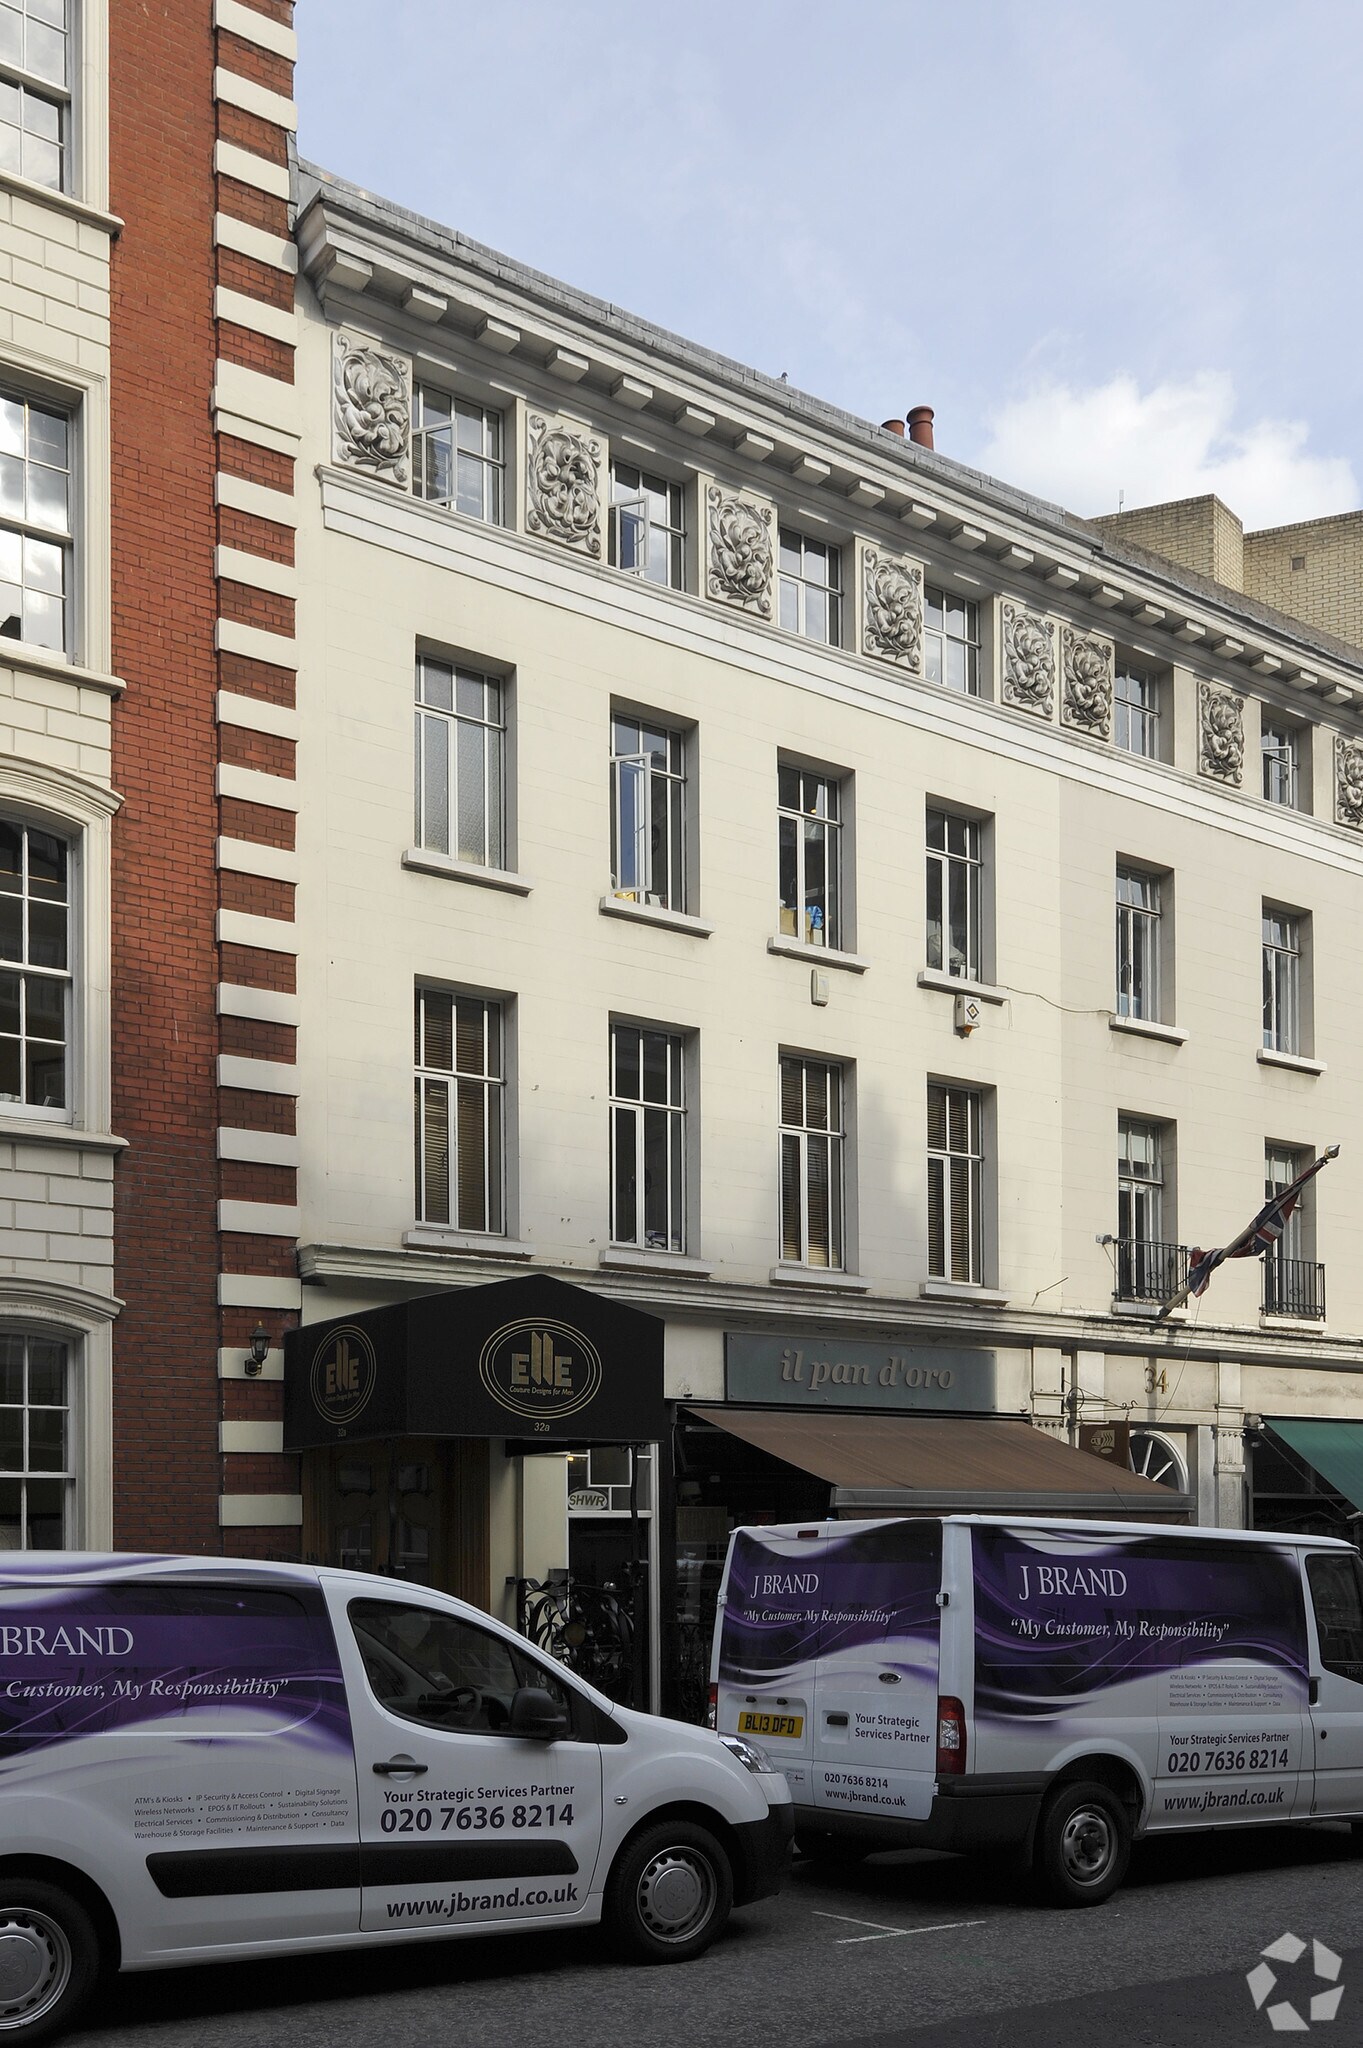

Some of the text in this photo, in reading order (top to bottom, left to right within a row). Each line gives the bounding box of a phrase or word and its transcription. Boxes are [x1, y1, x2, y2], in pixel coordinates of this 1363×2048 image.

[781, 1349, 955, 1391] il pan d'oro
[1144, 1366, 1169, 1394] 34
[510, 1385, 574, 1396] Couture Designs for Men
[534, 1422, 550, 1432] 32a
[570, 1494, 606, 1506] SHWR
[750, 1573, 820, 1598] J BRAND
[1019, 1566, 1128, 1600] J BRAND
[761, 1610, 802, 1622] Customer,
[804, 1610, 820, 1624] My
[1045, 1618, 1111, 1638] Customer,
[1114, 1620, 1136, 1640] My
[0, 1626, 134, 1656] BRAND
[6, 1680, 105, 1699] Customer,
[112, 1679, 143, 1700] My
[745, 1714, 795, 1734] BL13 DFD
[855, 1712, 920, 1728] Your Strategic
[855, 1728, 930, 1743] Services Partner
[1170, 1732, 1290, 1746] Your Strategic Services Partner
[1168, 1748, 1288, 1772] 020 7636 8214
[824, 1773, 888, 1788] 020 7636 8214
[295, 1789, 315, 1797] Digital
[316, 1788, 340, 1796] Signage
[384, 1784, 574, 1803] Your Strategic Services Partner
[825, 1789, 906, 1806] www.jbrand.co.uk
[1164, 1787, 1284, 1812] www.jbrand.co.uk
[164, 1806, 195, 1814] Networks
[380, 1804, 574, 1832] 020 7636 8214
[134, 1820, 164, 1828] Electrical
[134, 1831, 172, 1839] Warehouse
[180, 1829, 204, 1837] Storage
[206, 1827, 233, 1835] Facilities
[294, 1822, 319, 1830] Support
[386, 1883, 579, 1918] www.jbrand.co.uk
